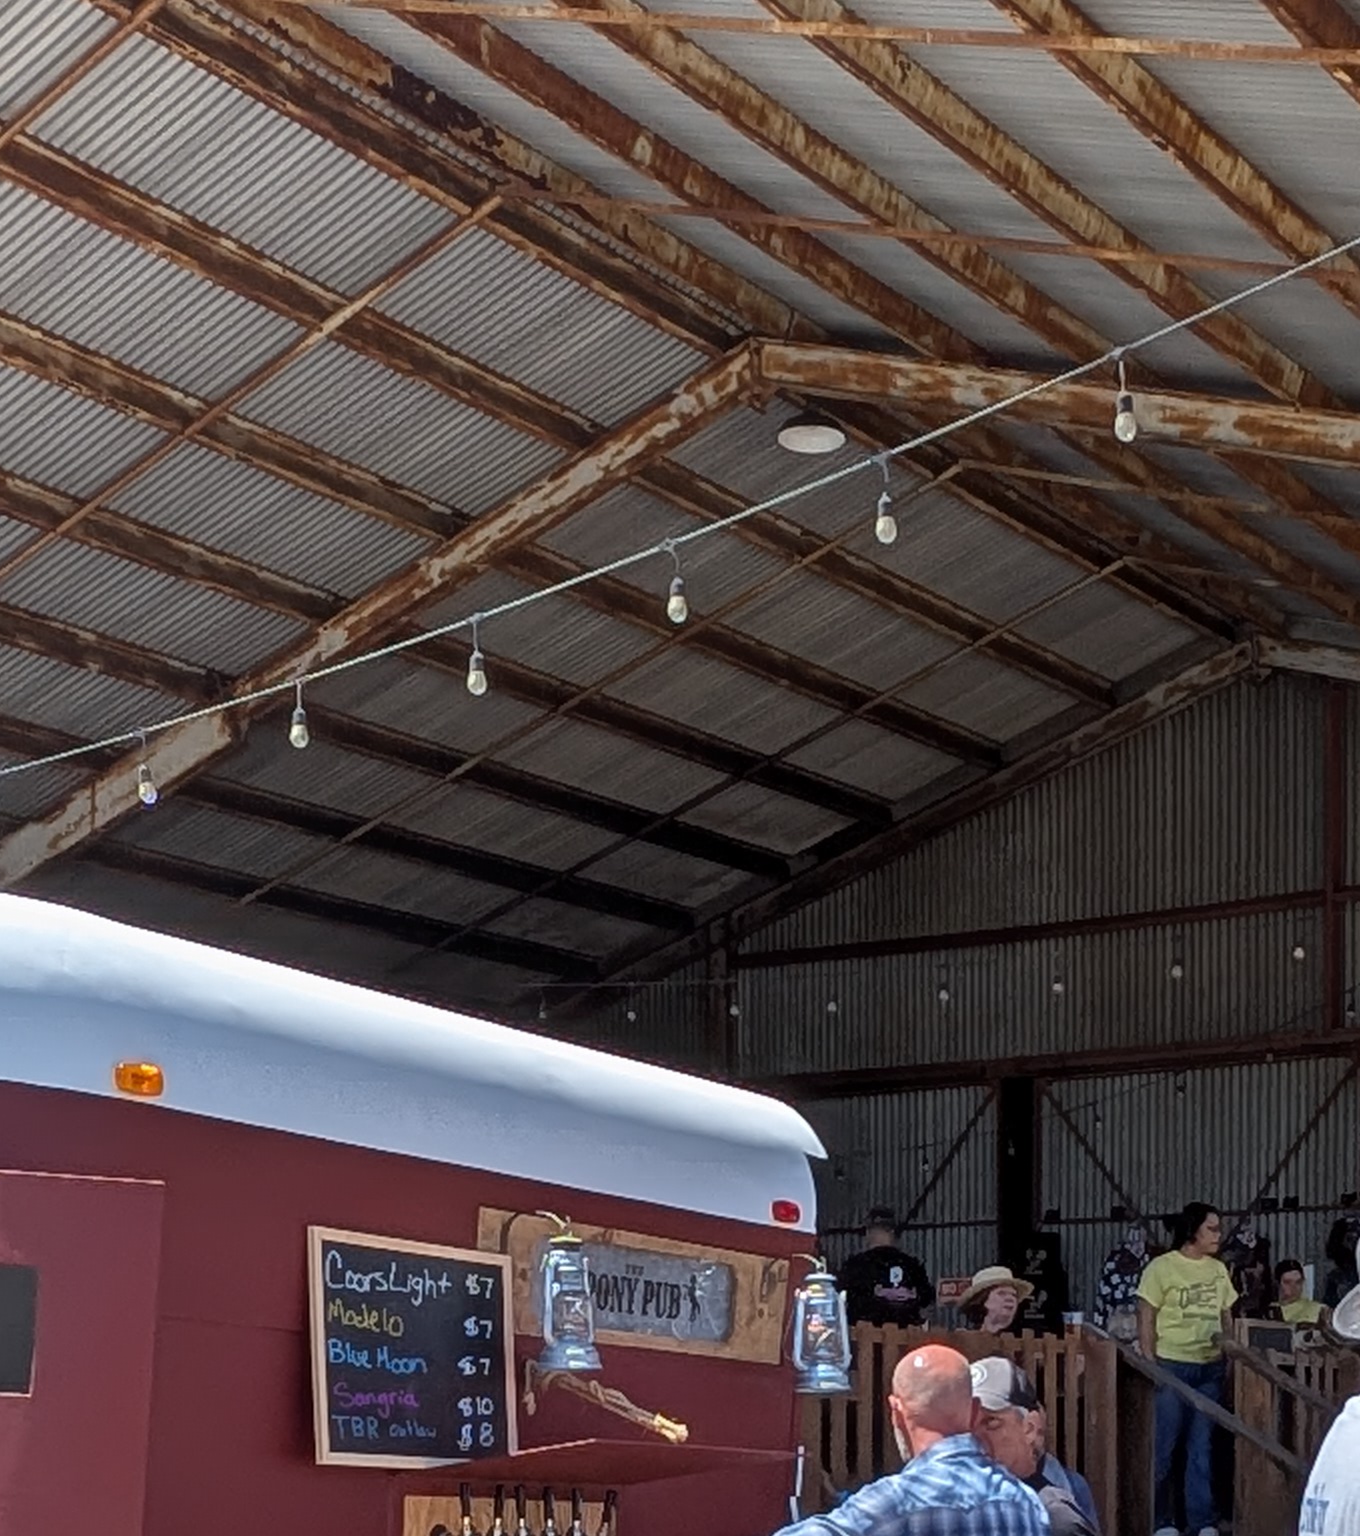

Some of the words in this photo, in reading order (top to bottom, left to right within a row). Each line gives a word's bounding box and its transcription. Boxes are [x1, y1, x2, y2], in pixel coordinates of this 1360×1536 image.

[465, 1272, 494, 1299] $7
[641, 1278, 682, 1320] PUB
[327, 1298, 404, 1337] Modelo
[463, 1316, 493, 1339] $7
[328, 1338, 372, 1369] Blue
[376, 1345, 428, 1374] Moon
[457, 1356, 491, 1375] $7
[457, 1396, 494, 1418] $10
[331, 1415, 380, 1440] TBR
